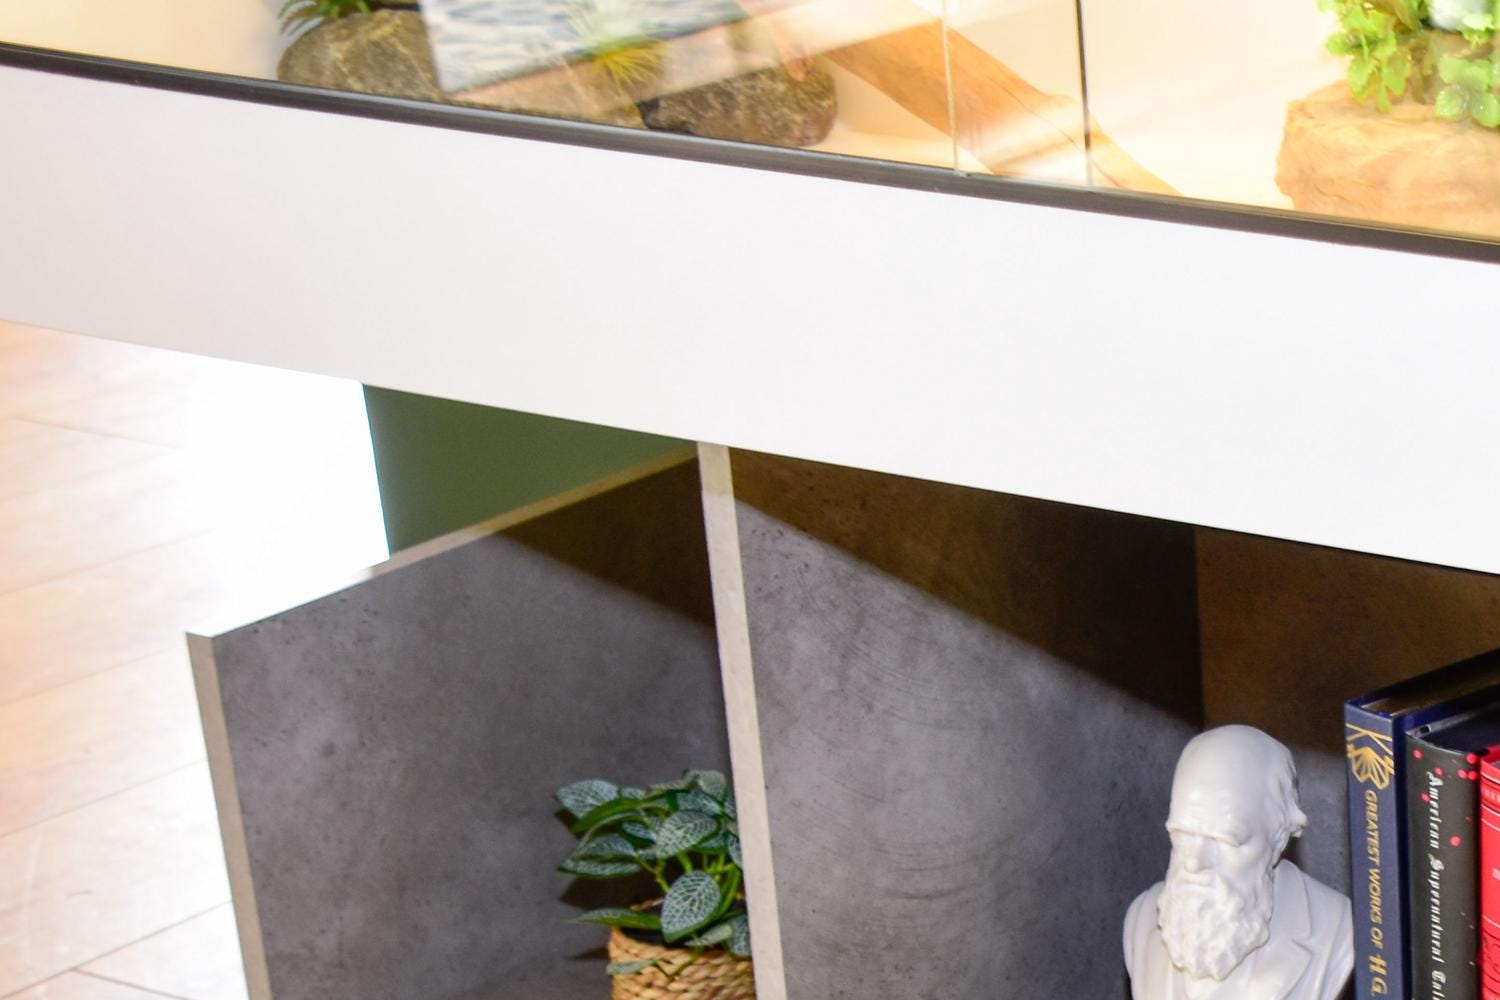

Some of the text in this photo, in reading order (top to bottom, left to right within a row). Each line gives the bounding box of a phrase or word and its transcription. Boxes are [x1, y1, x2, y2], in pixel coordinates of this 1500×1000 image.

[1363, 790, 1380, 865] GREATEST
[1426, 772, 1444, 849] American
[1368, 868, 1382, 924] WORKS
[1428, 853, 1446, 964] Supernatural
[1370, 927, 1384, 949] OF
